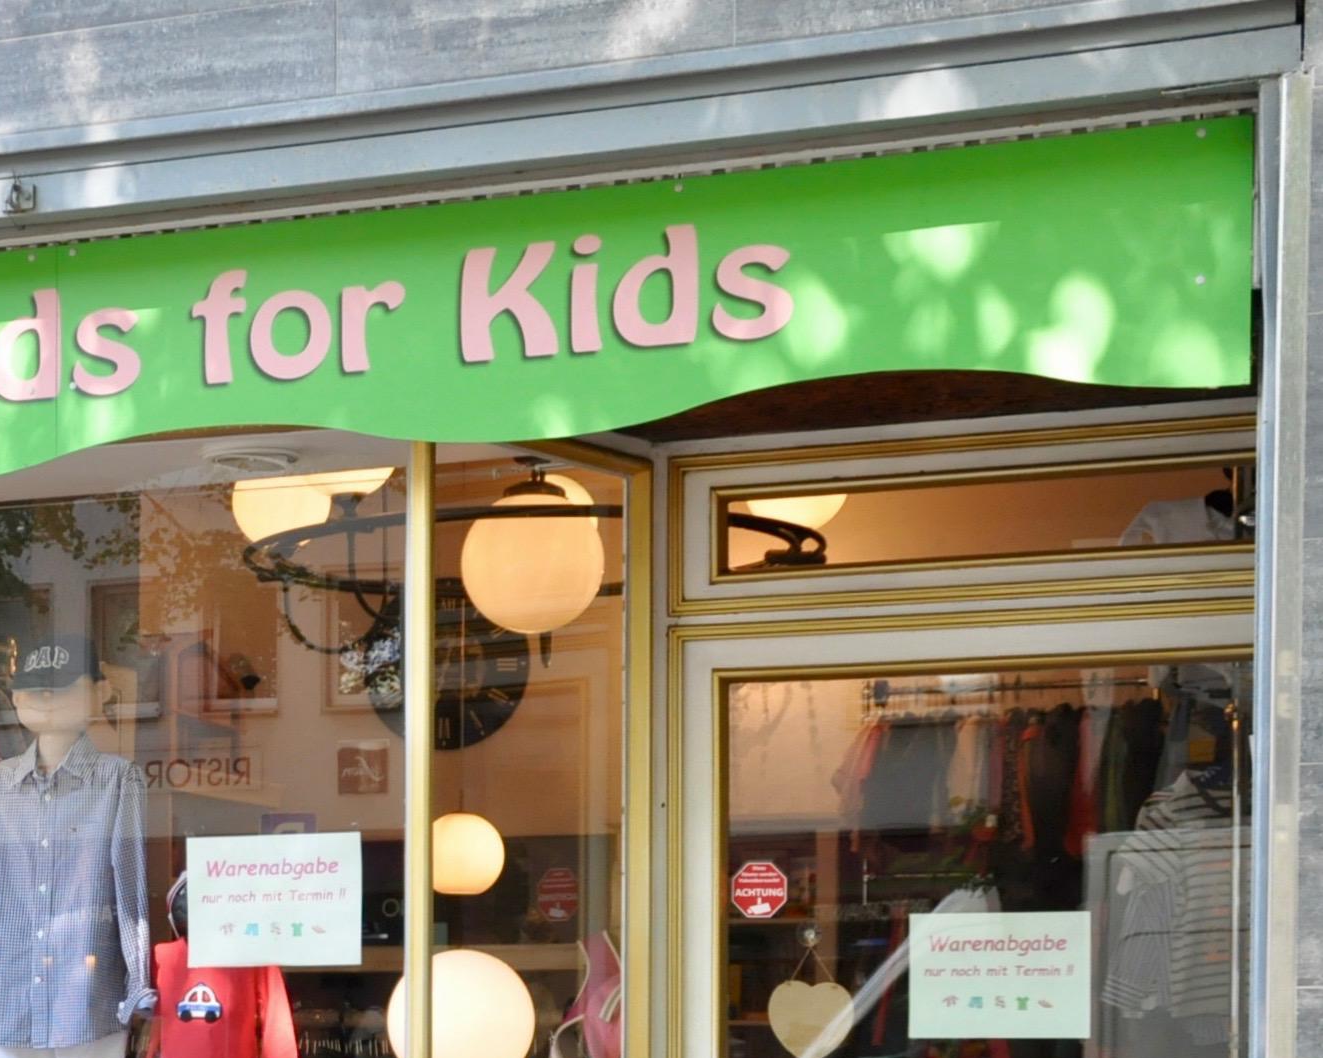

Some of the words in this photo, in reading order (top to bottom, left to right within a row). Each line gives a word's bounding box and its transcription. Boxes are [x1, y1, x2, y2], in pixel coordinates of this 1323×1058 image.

[191, 268, 406, 385] for
[459, 223, 794, 363] Kids
[206, 856, 339, 880] Warenabgabe
[201, 893, 223, 904] nur
[228, 889, 256, 903] noch
[262, 890, 283, 902] mit
[290, 889, 333, 902] Termin
[735, 887, 784, 897] ACHTUNG
[929, 934, 1068, 957] Warenabgabe
[924, 967, 946, 977] nur
[950, 965, 981, 977] noch
[986, 965, 1008, 977] mit
[1014, 964, 1061, 977] Termin
